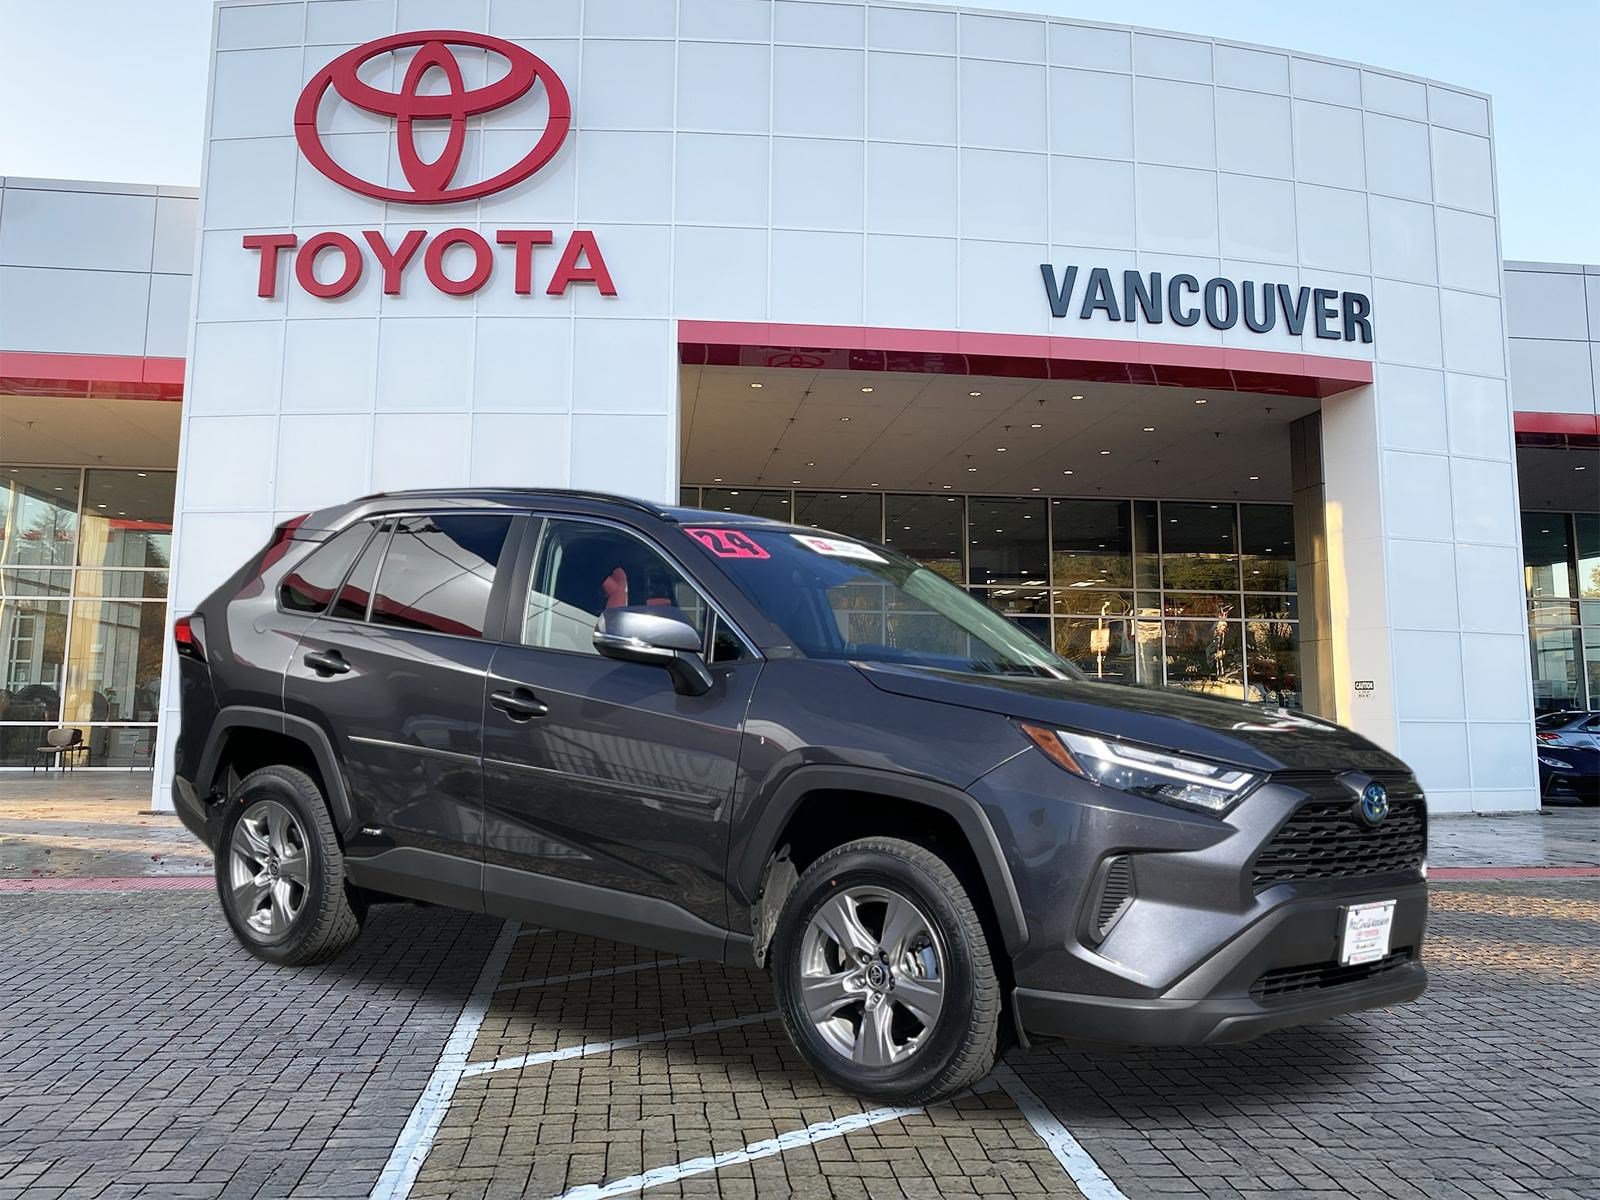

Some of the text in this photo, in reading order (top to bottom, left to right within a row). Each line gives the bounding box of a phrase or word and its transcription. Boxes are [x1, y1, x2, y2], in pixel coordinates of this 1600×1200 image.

[243, 228, 617, 299] TOYOTA
[1040, 264, 1373, 343] VANCOUVER
[693, 531, 759, 555] 24
